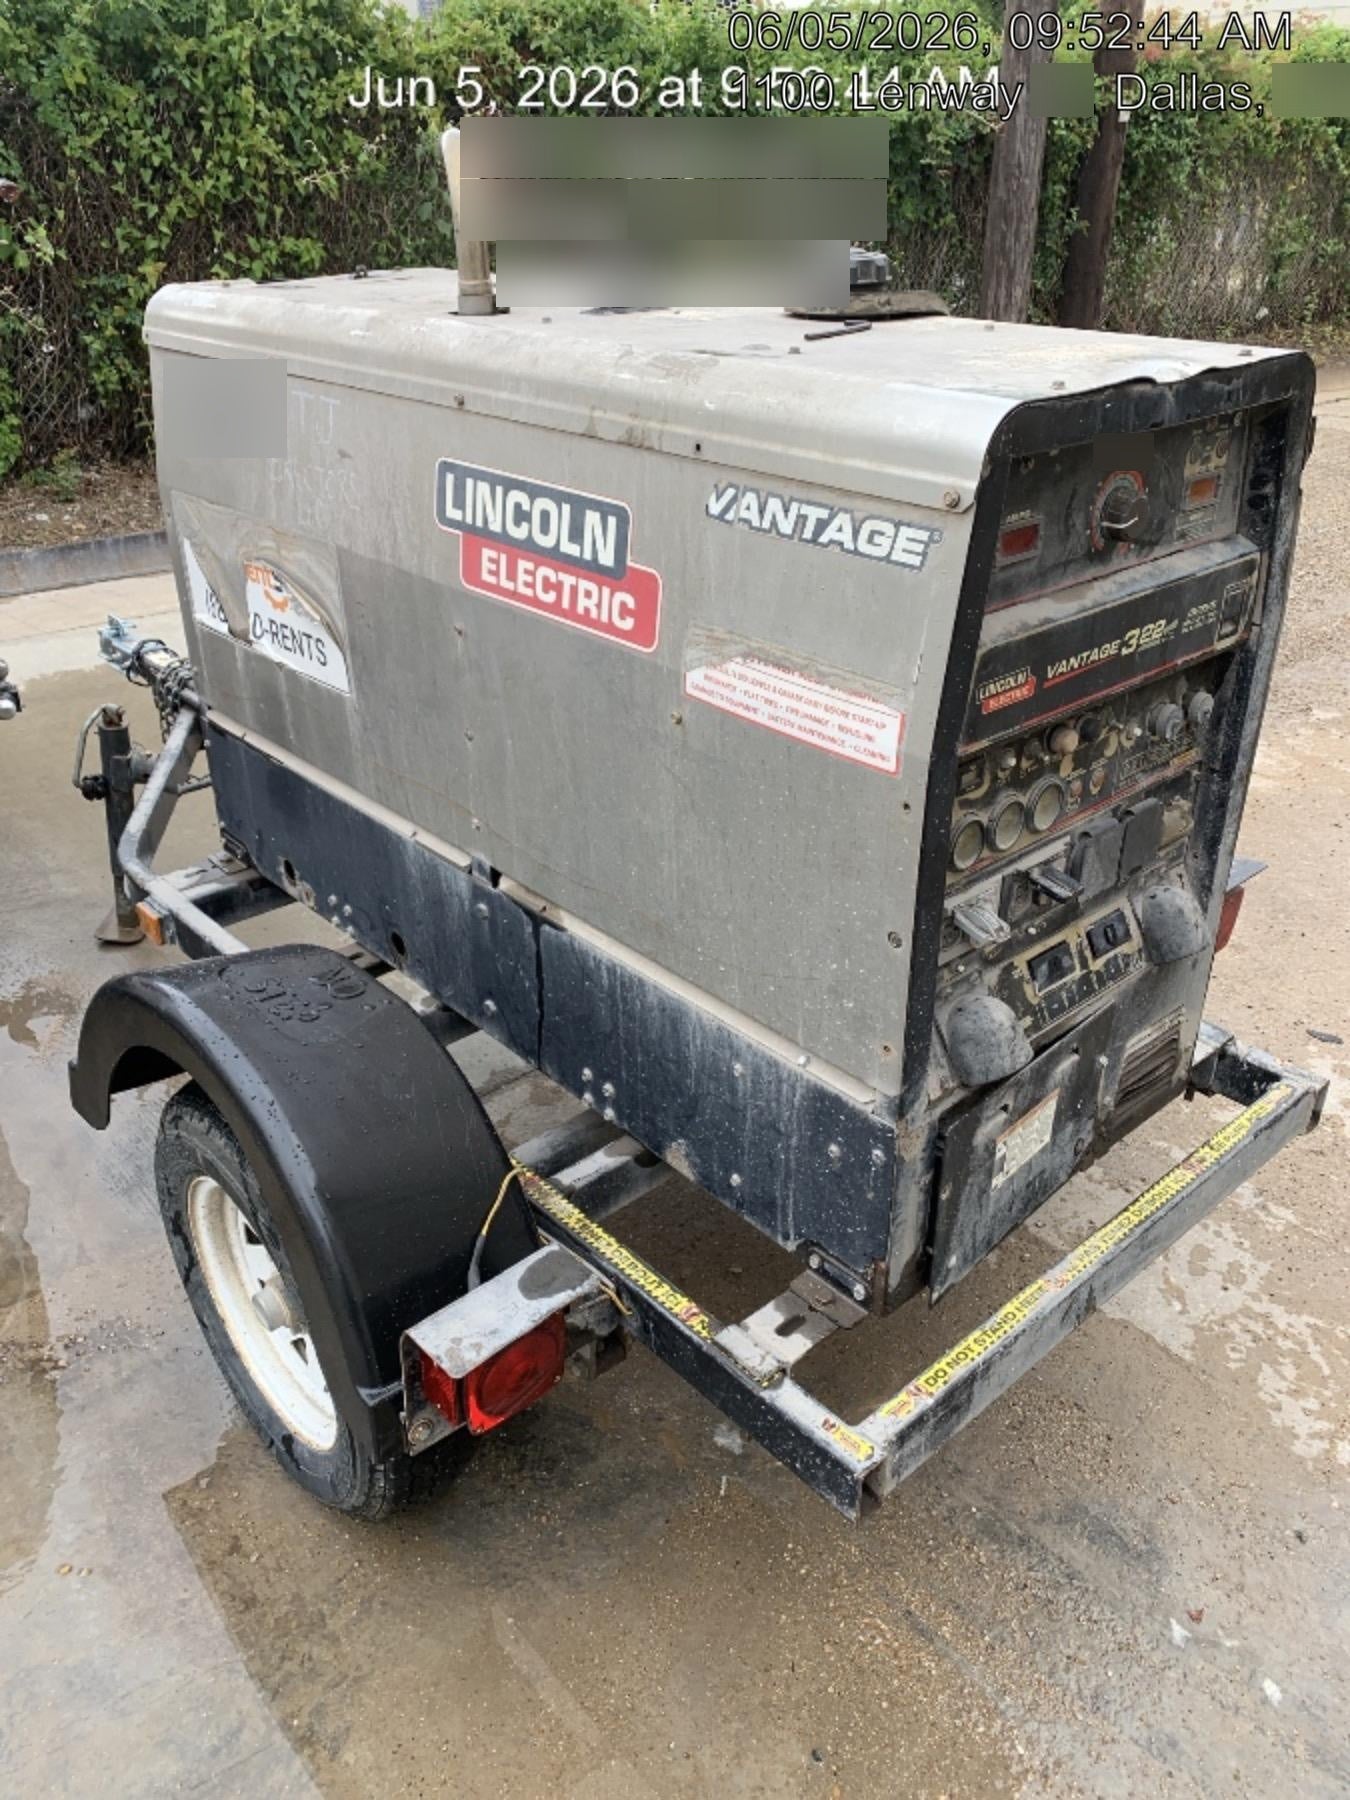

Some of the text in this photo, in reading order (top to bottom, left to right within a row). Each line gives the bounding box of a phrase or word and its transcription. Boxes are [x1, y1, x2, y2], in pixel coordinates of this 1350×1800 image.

[445, 472, 617, 568] LINCOLN
[481, 547, 635, 631] ELECTRIC
[980, 670, 1027, 699] LINCOLN
[1047, 640, 1121, 678] VANTAGE
[1121, 619, 1166, 656] 322
[923, 1365, 949, 1388] DO
[944, 1343, 977, 1371] NOT
[972, 1310, 1019, 1347] STAND
